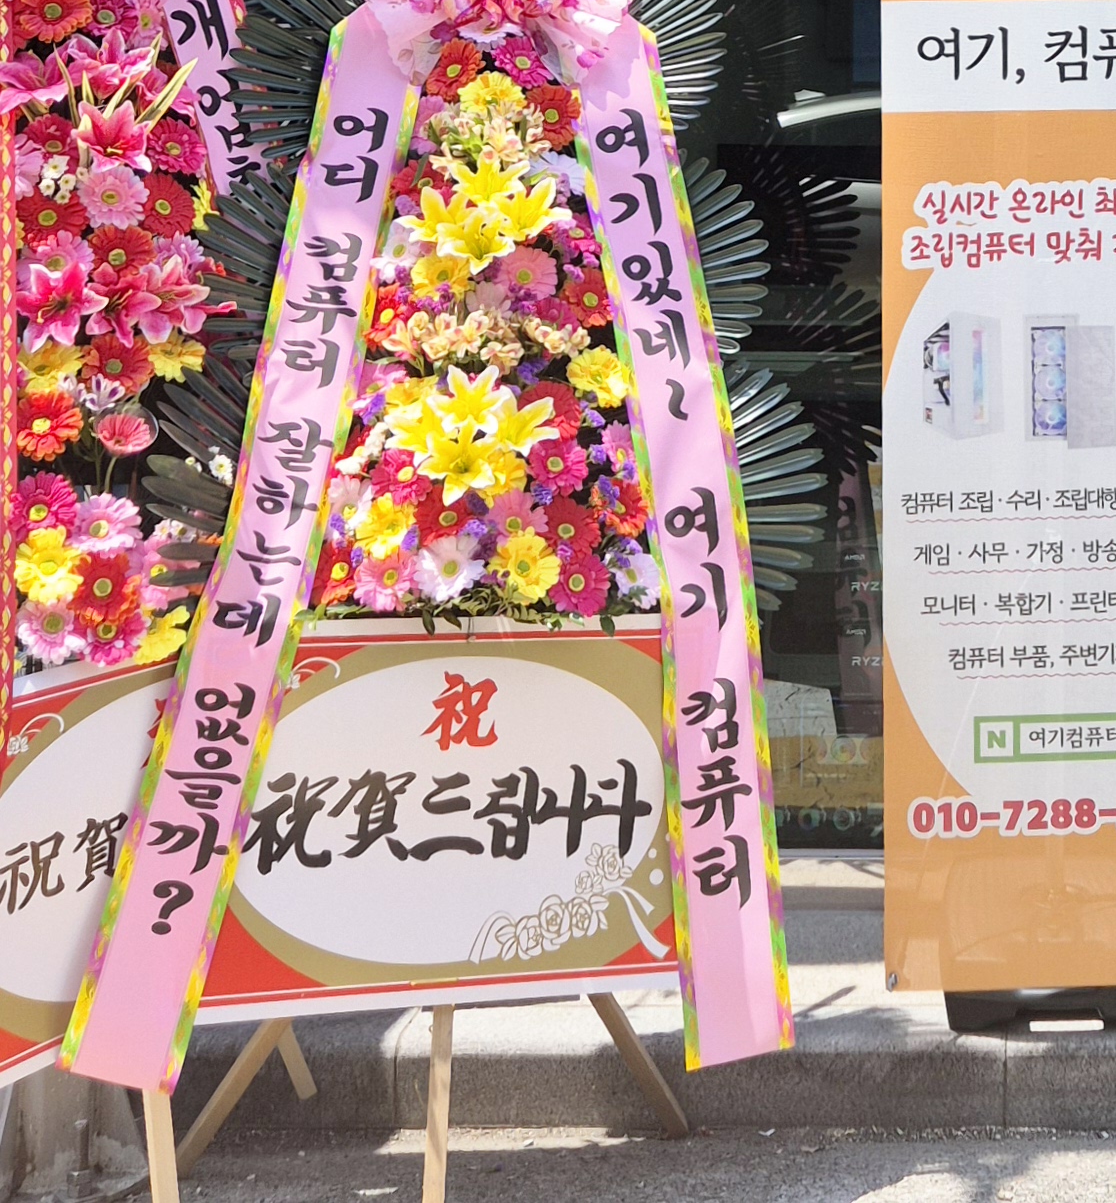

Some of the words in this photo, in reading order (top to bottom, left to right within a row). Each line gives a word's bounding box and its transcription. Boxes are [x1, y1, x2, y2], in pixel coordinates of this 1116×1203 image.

[918, 27, 1025, 84] 여기,
[321, 108, 389, 202] 어디
[922, 188, 999, 221] 실시간
[1007, 187, 1084, 223] 온라인
[910, 229, 1035, 268] 조립컴퓨터
[1047, 228, 1101, 265] 맞춰
[282, 233, 362, 388] 컴퓨터
[901, 491, 953, 515] 컴퓨터
[959, 490, 993, 513] 조립
[1006, 490, 1041, 511] 수리
[212, 418, 334, 648] 잘하는데
[664, 486, 729, 632] 여기
[914, 544, 949, 566] 게임
[969, 542, 1008, 564] 사무
[1027, 541, 1063, 564] 가정
[921, 594, 975, 616] 모니터
[995, 592, 1051, 616] 복합기
[949, 646, 1004, 670] 컴퓨터
[1010, 645, 1054, 668] 부품,
[420, 671, 498, 751] 祝
[988, 730, 1006, 749] N
[147, 682, 256, 935] 없을까?
[682, 678, 752, 909] 컴퓨터
